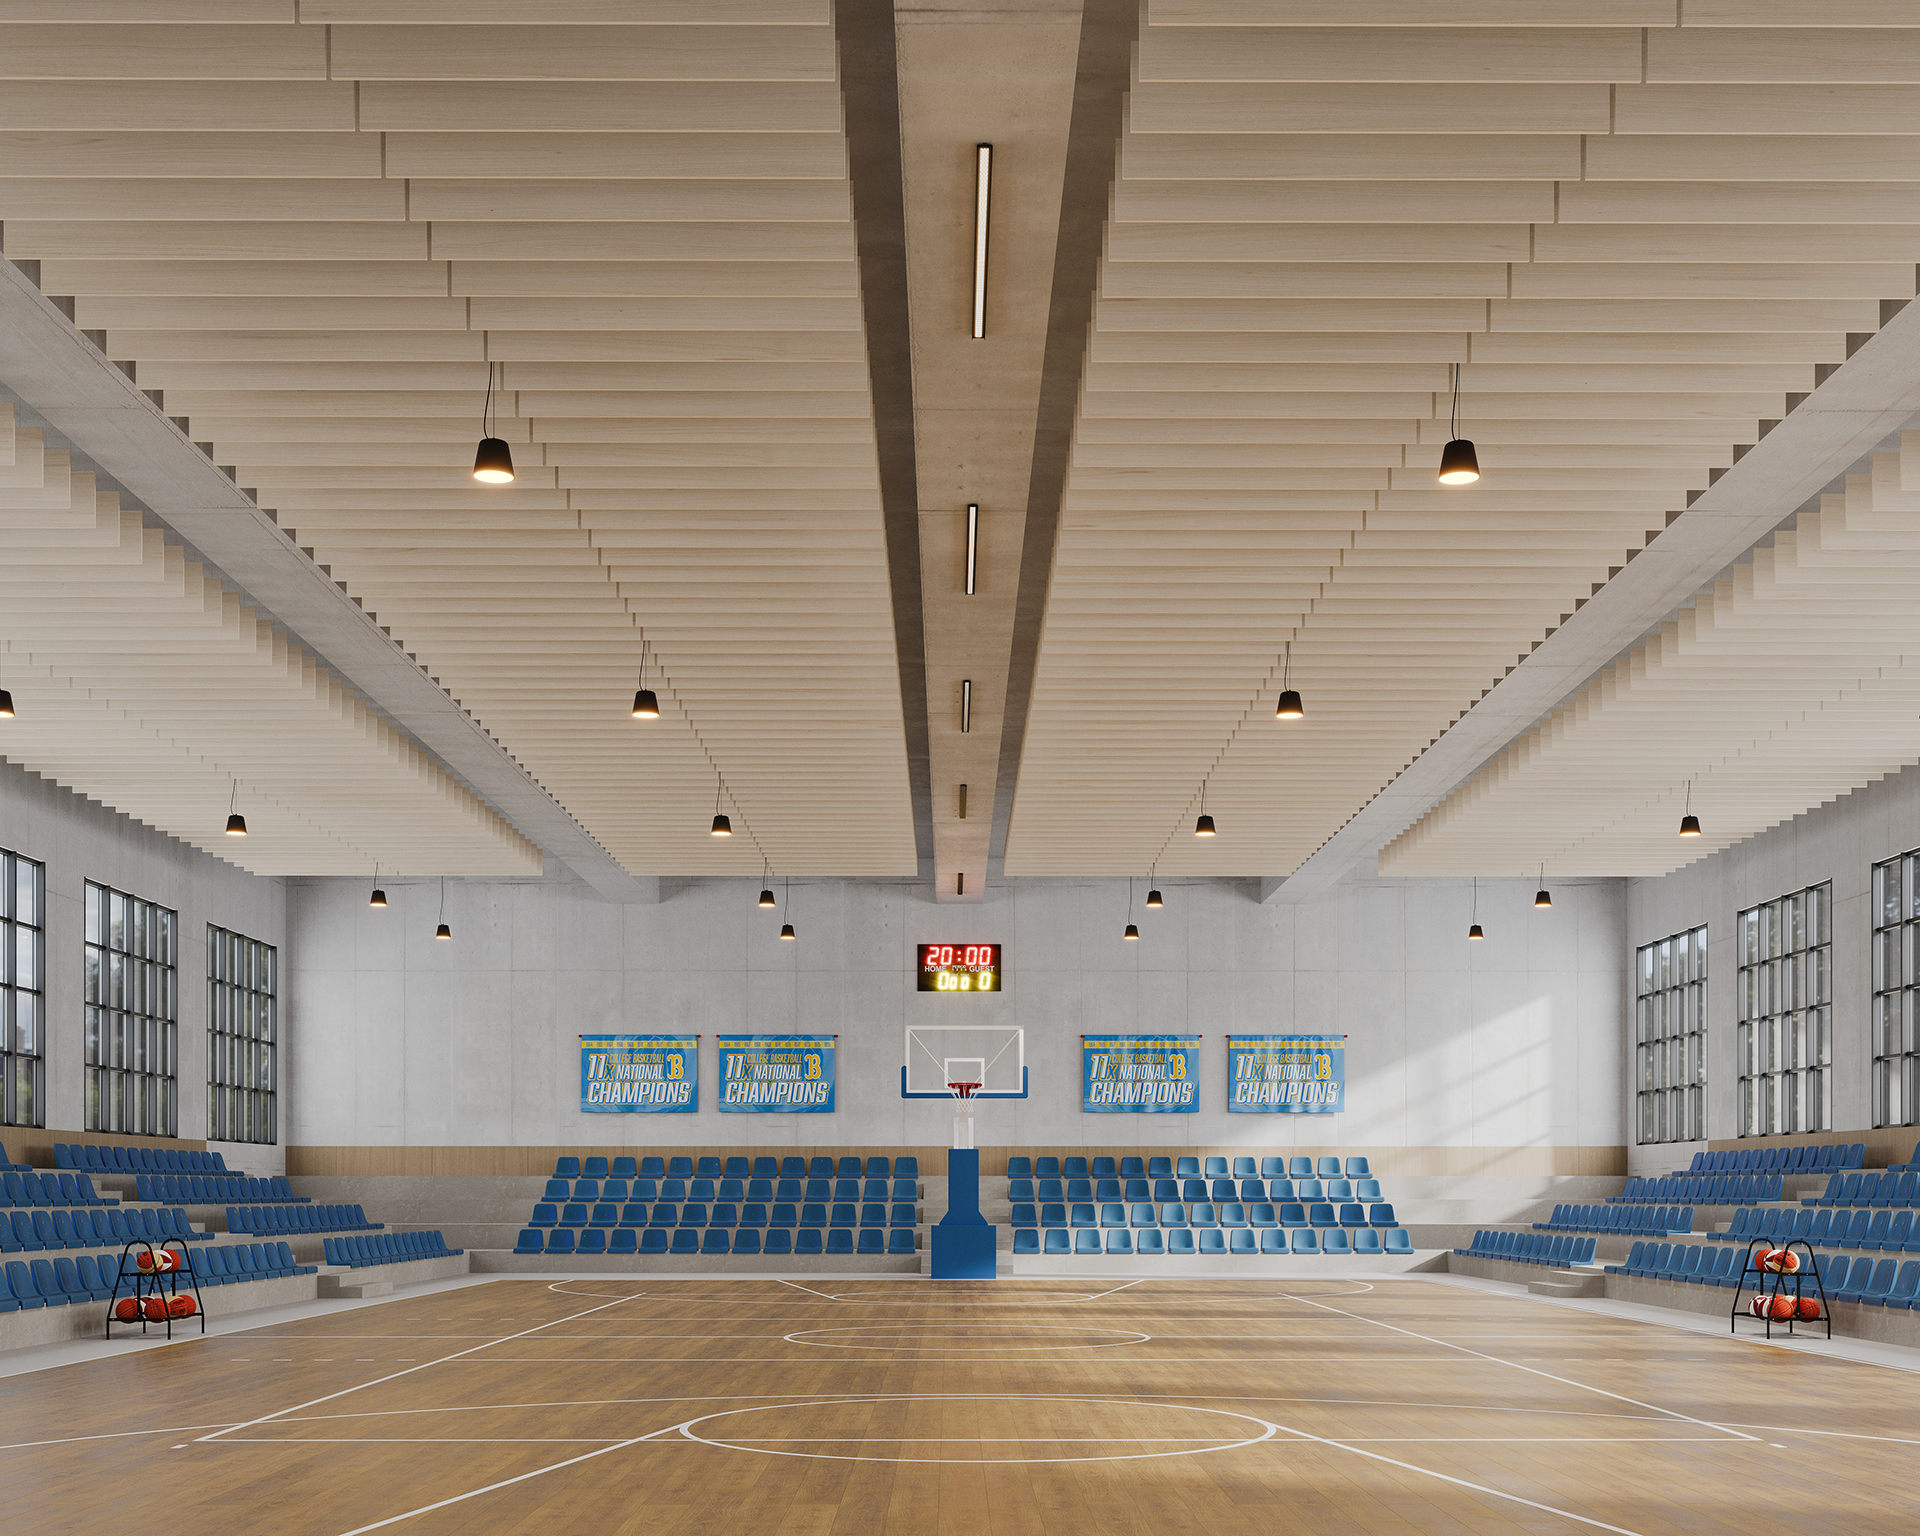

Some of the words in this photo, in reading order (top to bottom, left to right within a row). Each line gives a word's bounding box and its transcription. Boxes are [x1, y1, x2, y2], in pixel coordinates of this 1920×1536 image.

[926, 946, 992, 965] 20:00
[979, 972, 991, 990] 0
[609, 1054, 632, 1063] COLLEGE
[633, 1054, 664, 1063] BASKETBALL
[747, 1054, 770, 1063] COLLEGE
[770, 1054, 802, 1063] BASKETBALL
[1112, 1054, 1135, 1063] COLLEGE
[1135, 1054, 1167, 1063] BASKETBALL
[1257, 1054, 1280, 1063] COLLEGE
[1281, 1054, 1312, 1063] BASKETBALL
[616, 1064, 664, 1080] NATIONAL
[753, 1064, 802, 1080] NATIONAL
[1118, 1064, 1167, 1080] NATIONAL
[1264, 1064, 1312, 1080] NATIONAL
[587, 1081, 692, 1104] CHAMPIONS
[725, 1081, 829, 1104] CHAMPIONS
[1090, 1081, 1194, 1104] CHAMPIONS
[1235, 1081, 1340, 1104] CHAMPIONS
